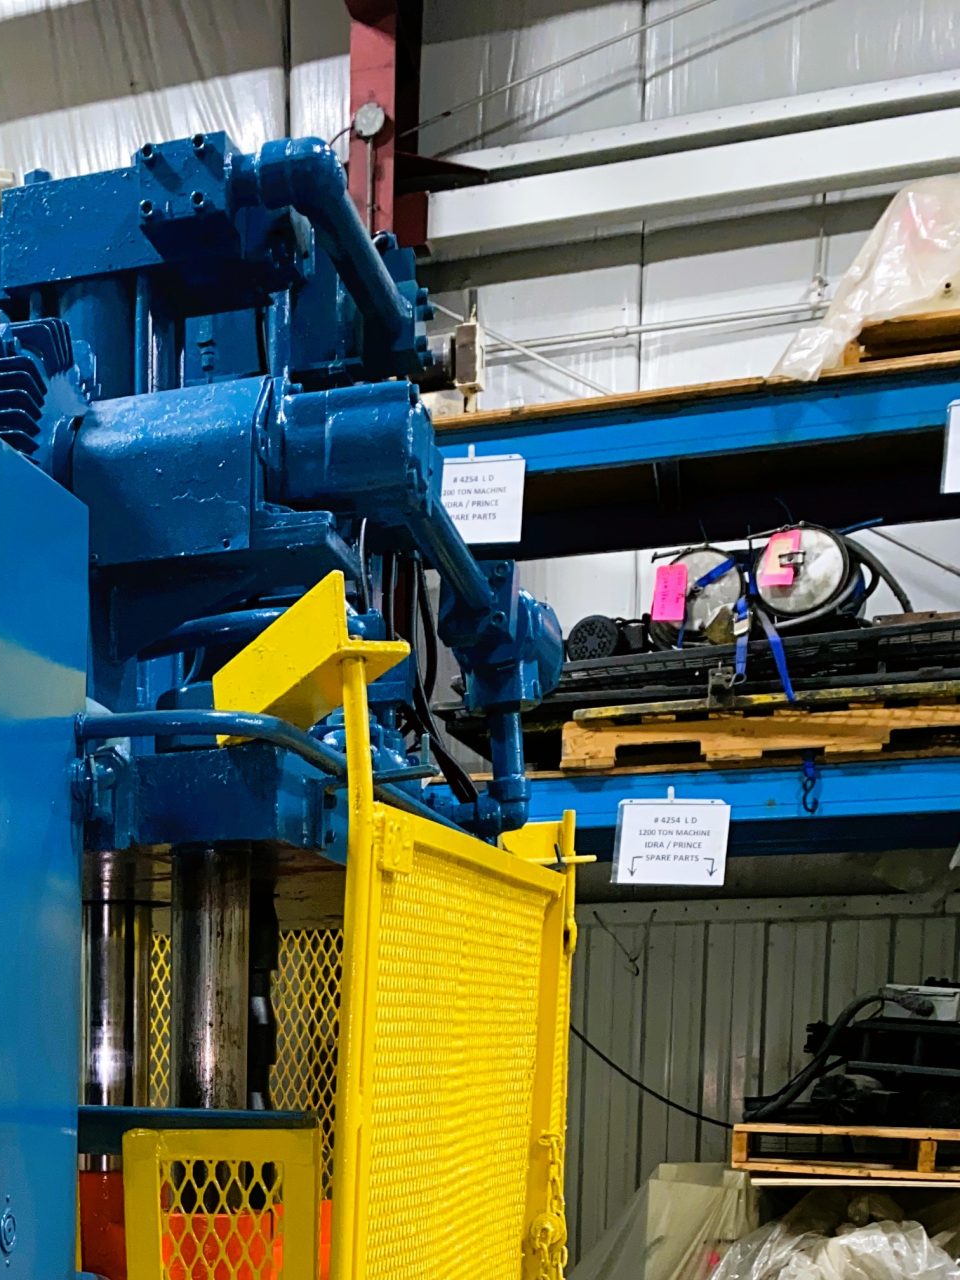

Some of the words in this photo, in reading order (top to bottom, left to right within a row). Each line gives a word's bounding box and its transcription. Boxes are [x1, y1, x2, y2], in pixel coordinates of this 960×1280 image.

[474, 486, 507, 494] MACHINE
[471, 499, 499, 507] PRINCE
[451, 513, 470, 521] PARE
[472, 512, 497, 520] PARTS
[661, 816, 681, 824] 4254
[644, 841, 665, 849] IDRA
[673, 854, 700, 862] PARTS
